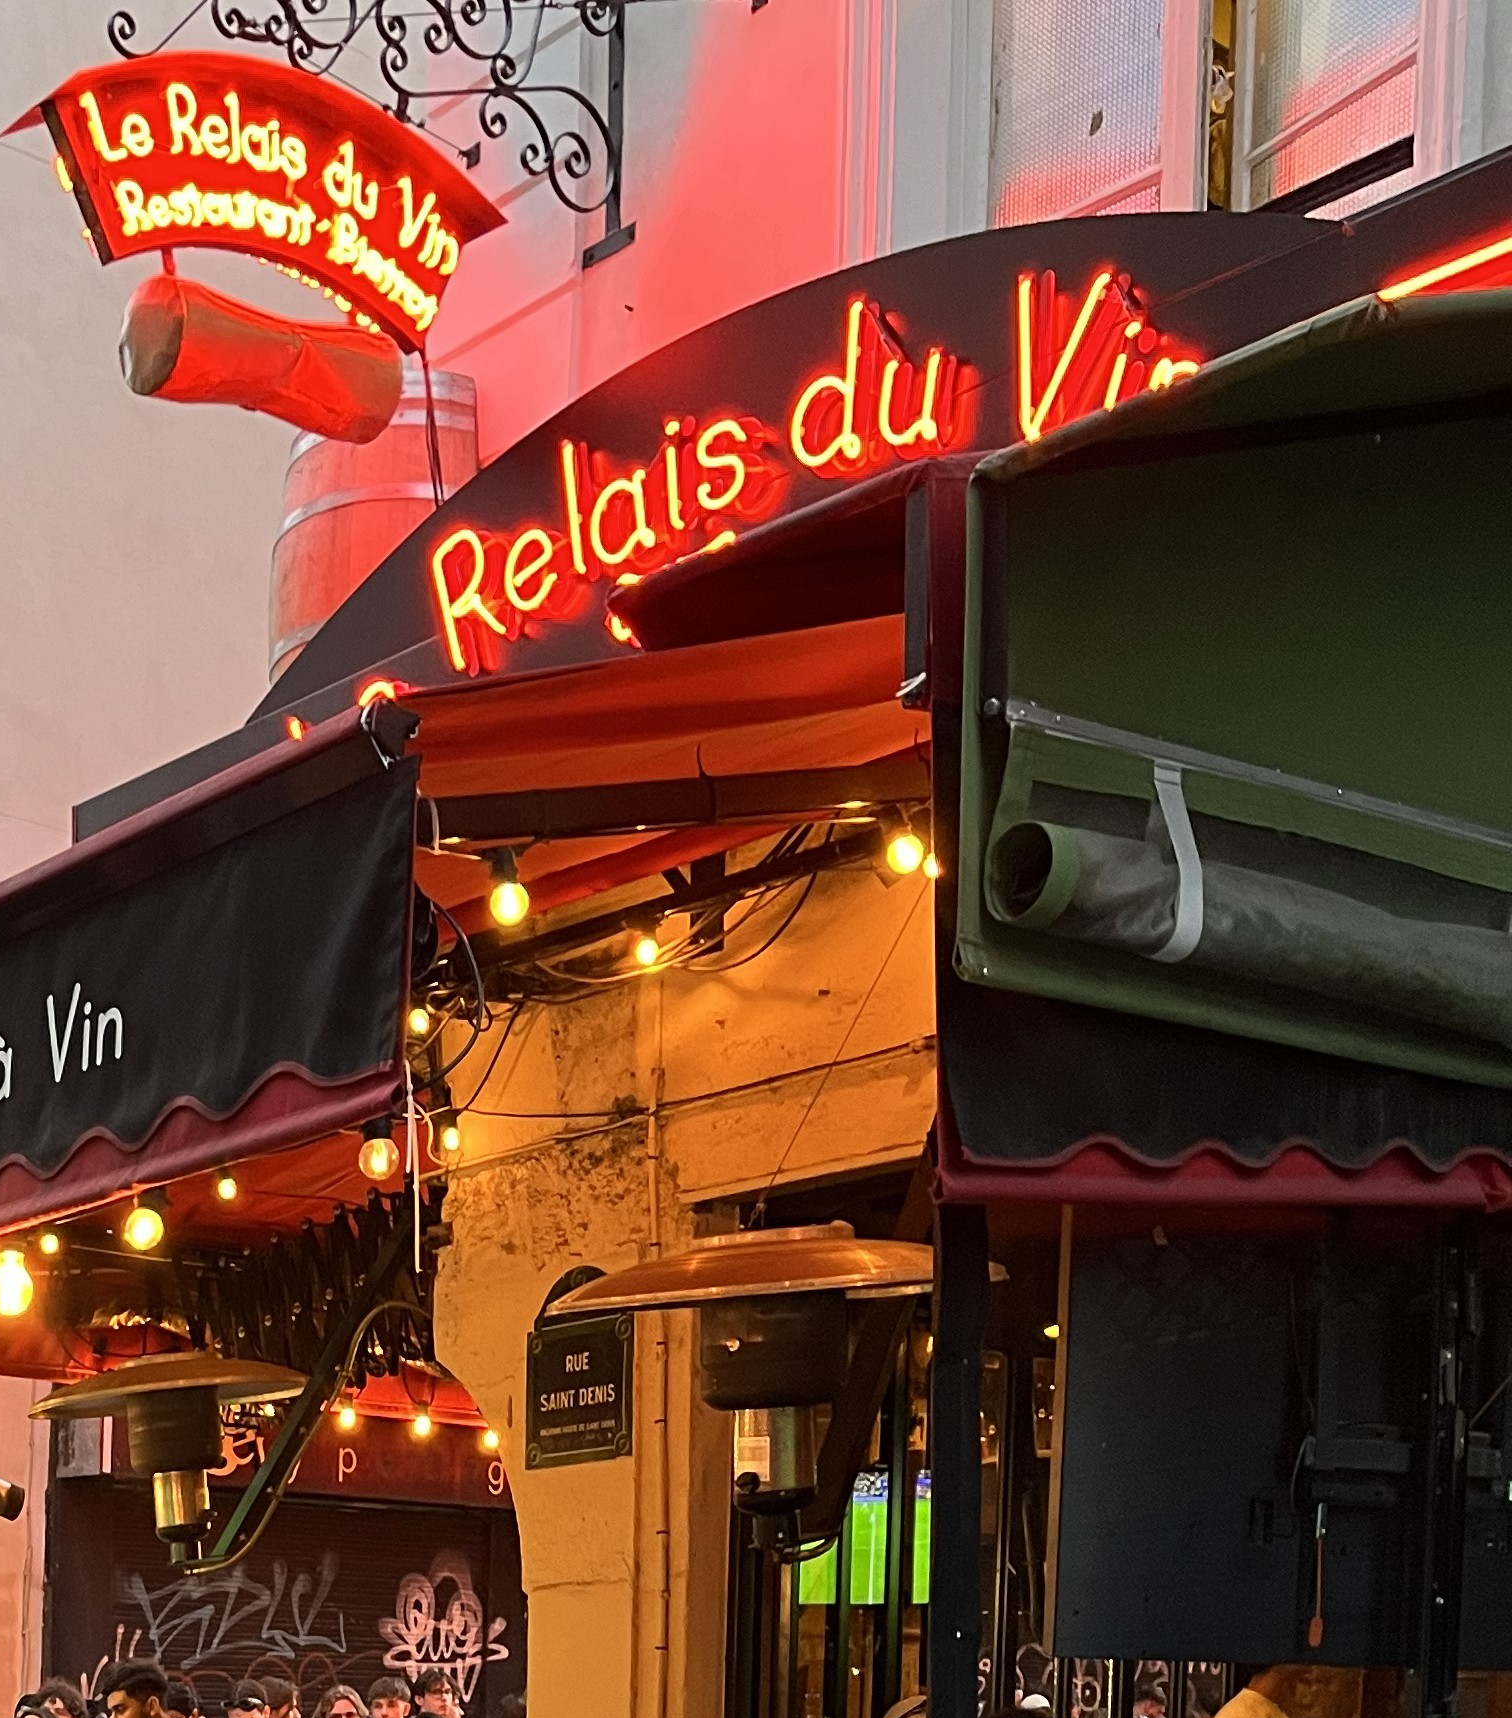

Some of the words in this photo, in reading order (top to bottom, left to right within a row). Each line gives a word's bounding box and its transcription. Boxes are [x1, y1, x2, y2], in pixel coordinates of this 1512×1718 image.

[79, 91, 155, 162] Le
[166, 82, 307, 181] Relais
[322, 141, 378, 220] du
[397, 175, 460, 276] Vin
[430, 417, 748, 673] Relais
[790, 297, 942, 464] du
[46, 982, 124, 1083] Vin
[540, 1389, 576, 1412] SAINT
[579, 1384, 616, 1407] DENIS
[565, 1351, 590, 1373] RUE
